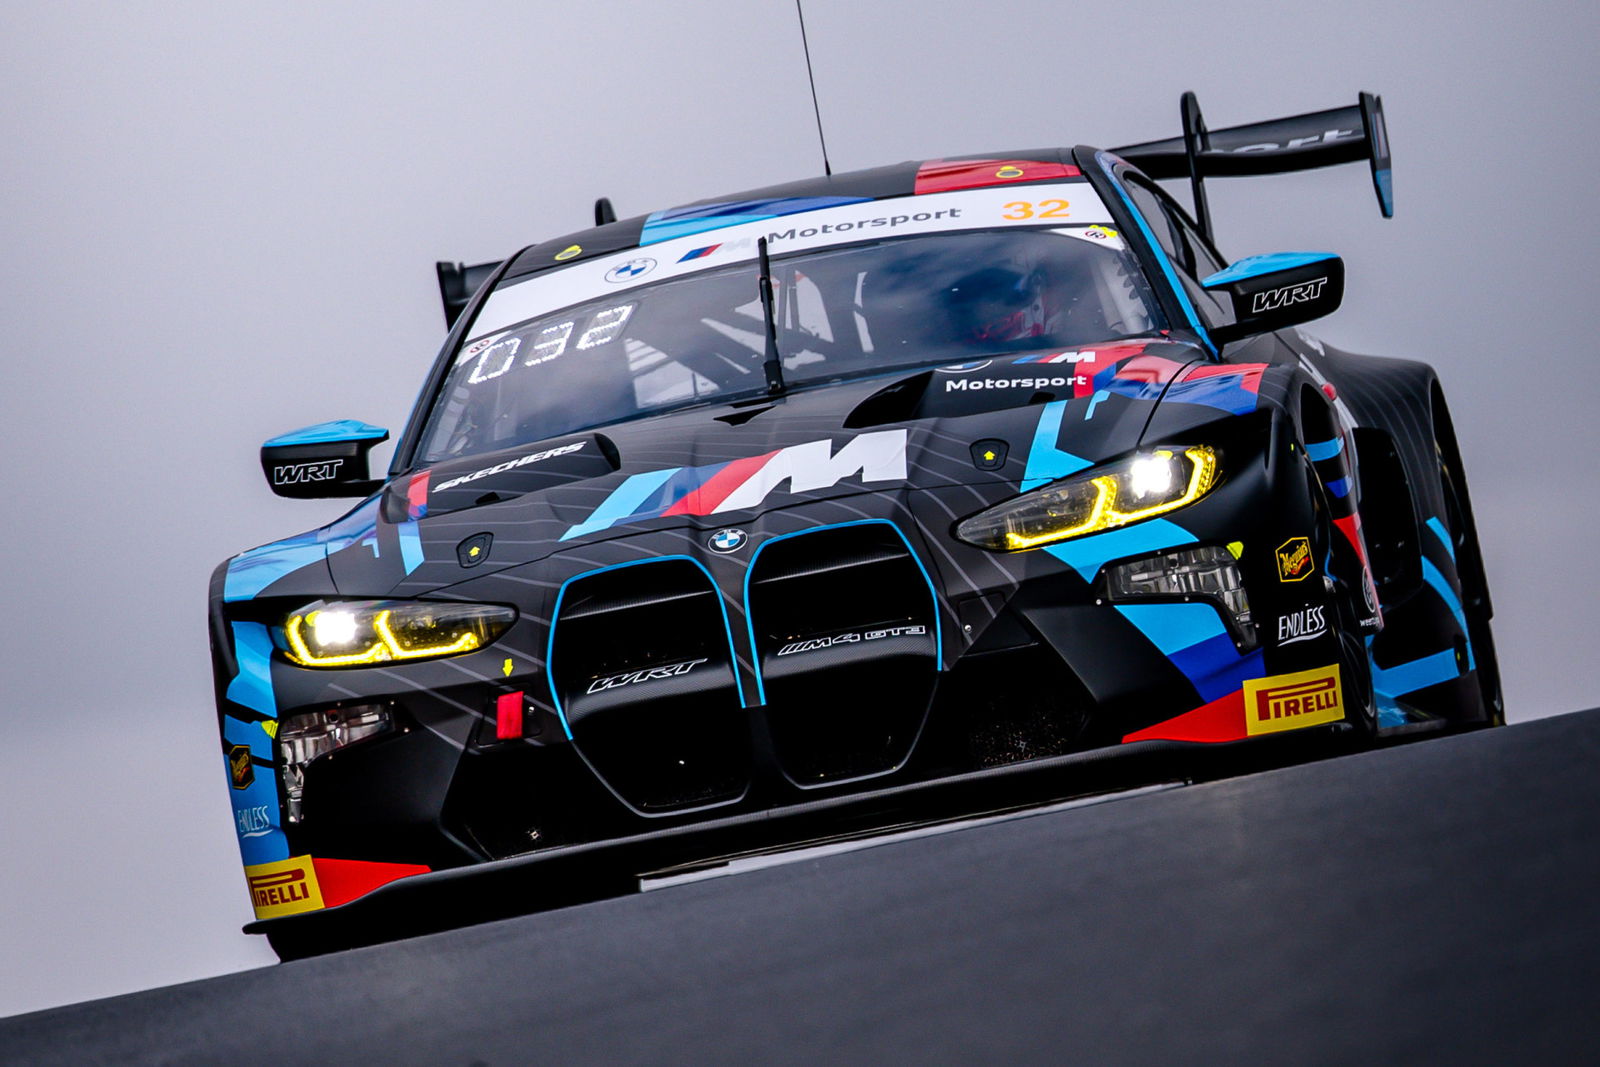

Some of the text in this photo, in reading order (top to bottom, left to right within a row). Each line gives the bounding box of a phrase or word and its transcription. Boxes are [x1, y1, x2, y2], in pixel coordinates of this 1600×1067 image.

[767, 207, 961, 243] Motorsport
[1002, 199, 1070, 220] 32
[1252, 276, 1328, 313] WRT
[467, 304, 633, 384] 032
[1047, 351, 1096, 364] M
[945, 375, 1087, 392] Motorsport
[274, 459, 343, 485] WRT
[432, 441, 587, 493] SKECHERS
[865, 625, 926, 641] GT3
[1278, 604, 1325, 641] ENDLESS
[586, 658, 708, 695] WRT
[1256, 676, 1338, 721] PIRELLI
[237, 804, 270, 834] ENDLESS
[248, 868, 310, 908] PIRELLI
